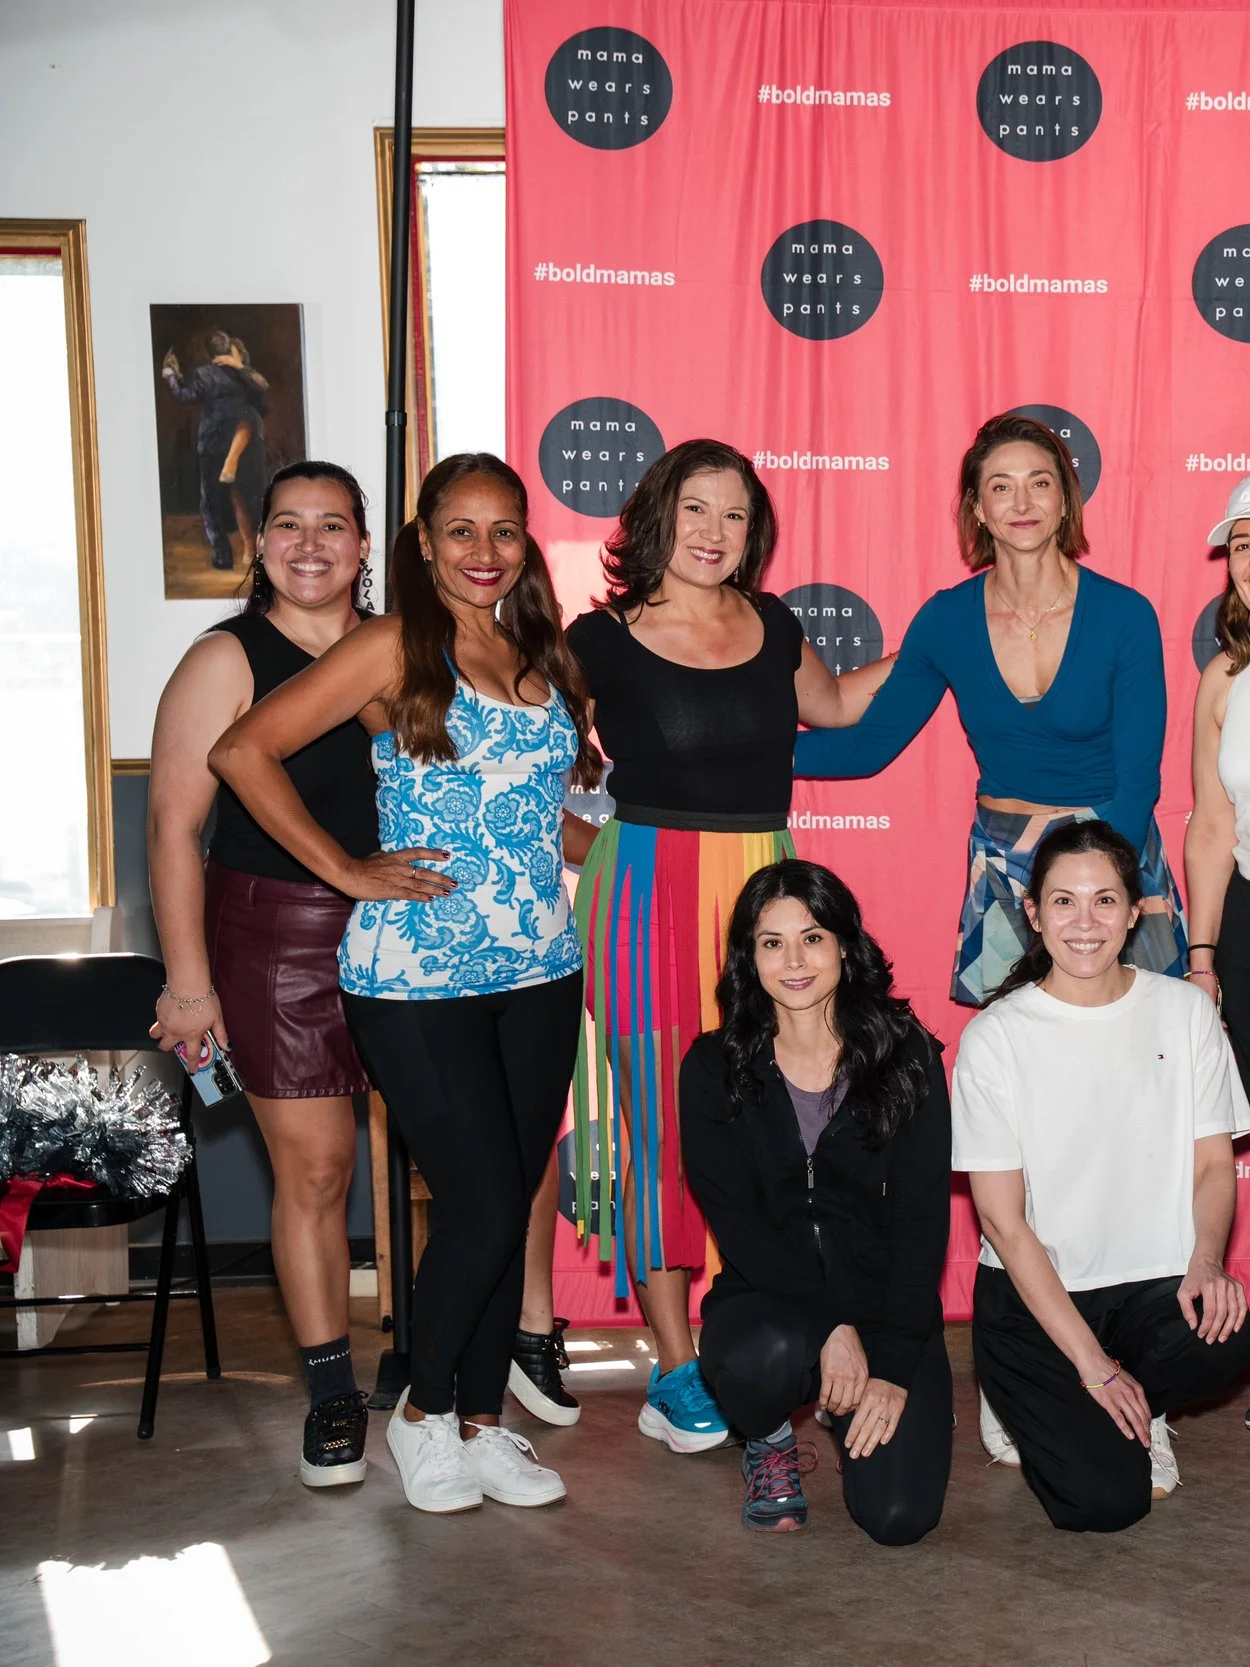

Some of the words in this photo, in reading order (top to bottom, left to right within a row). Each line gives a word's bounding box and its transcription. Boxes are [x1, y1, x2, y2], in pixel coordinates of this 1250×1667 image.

[577, 49, 643, 64] mama
[1007, 64, 1072, 76] mama
[568, 79, 650, 95] wears
[758, 84, 891, 107] #boldmamas
[999, 94, 1080, 106] wears
[568, 110, 648, 126] pants
[999, 123, 1079, 138] pants
[791, 244, 853, 255] mama
[533, 261, 676, 286] #boldmamas
[783, 273, 862, 285] wears
[968, 273, 1109, 294] #boldmamas
[783, 301, 860, 317] pants
[570, 420, 636, 432] mama
[561, 449, 644, 462] wears
[752, 450, 890, 471] #boldmamas
[562, 479, 639, 494] pant
[789, 606, 853, 618] mama
[805, 635, 862, 648] ars
[786, 810, 892, 830] ldmamas
